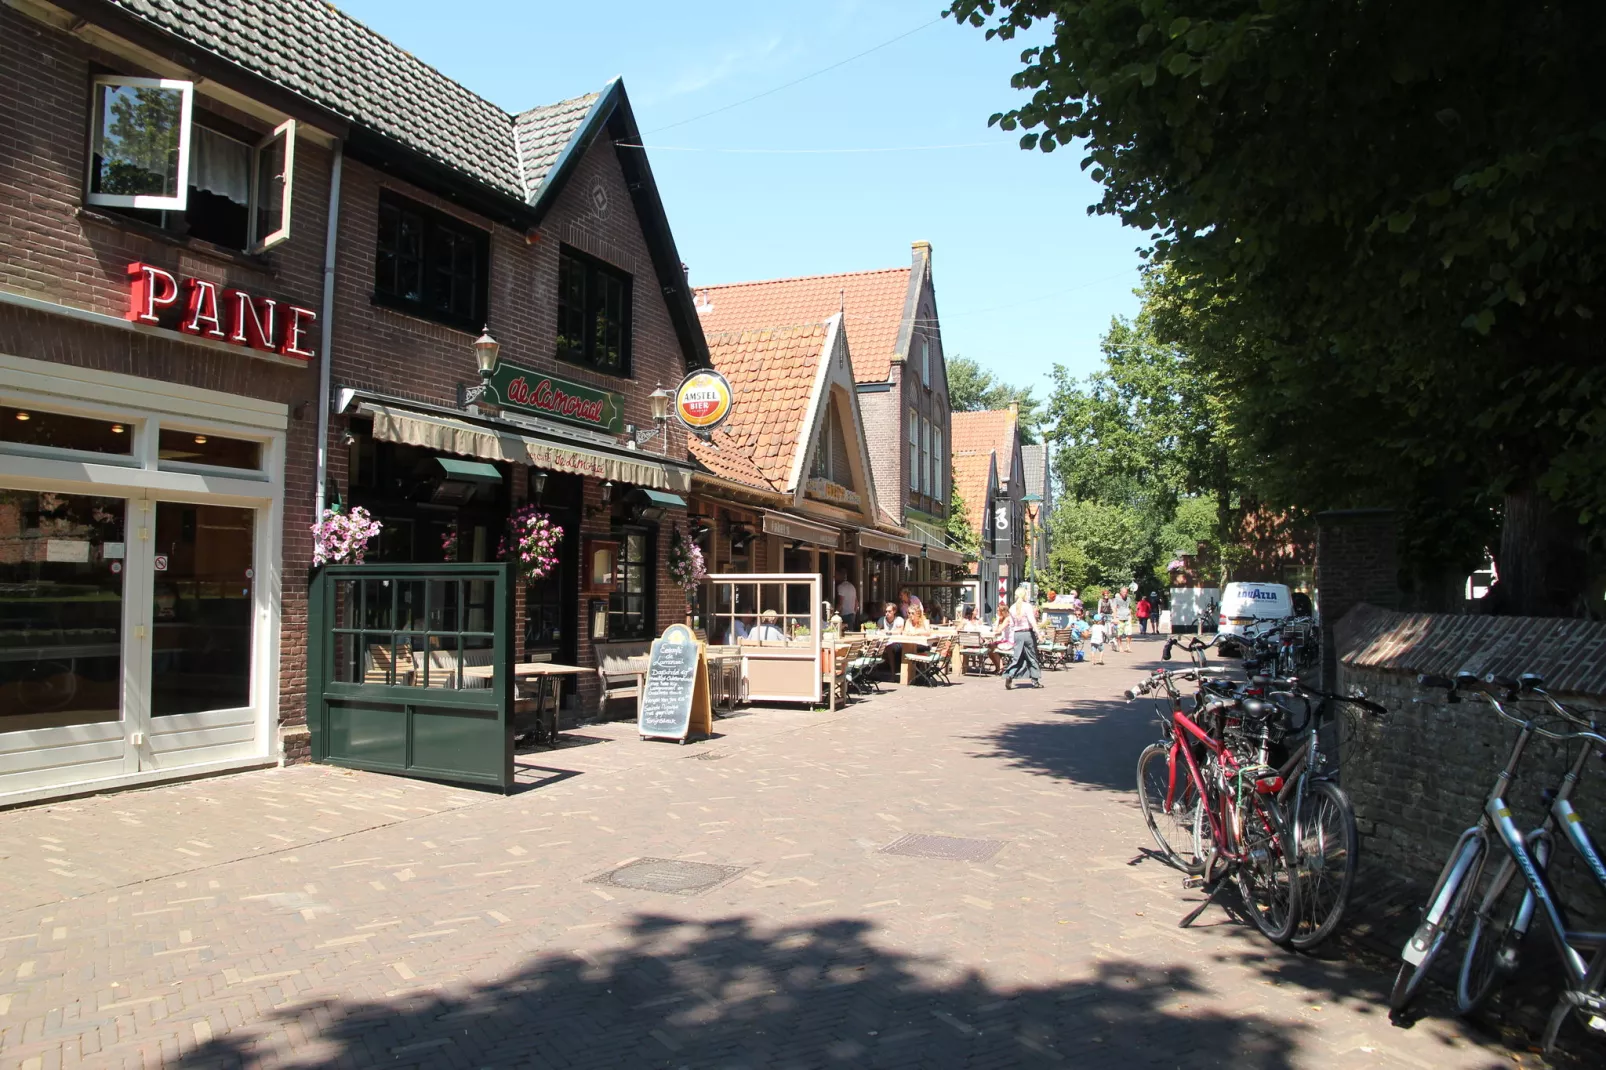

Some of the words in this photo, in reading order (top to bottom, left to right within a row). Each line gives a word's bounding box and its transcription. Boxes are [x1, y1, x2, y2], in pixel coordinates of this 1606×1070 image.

[125, 261, 317, 361] PANE
[508, 376, 529, 404] de
[529, 379, 603, 422] Lamoraal
[684, 391, 717, 401] AMSTEL
[690, 402, 709, 410] BIER
